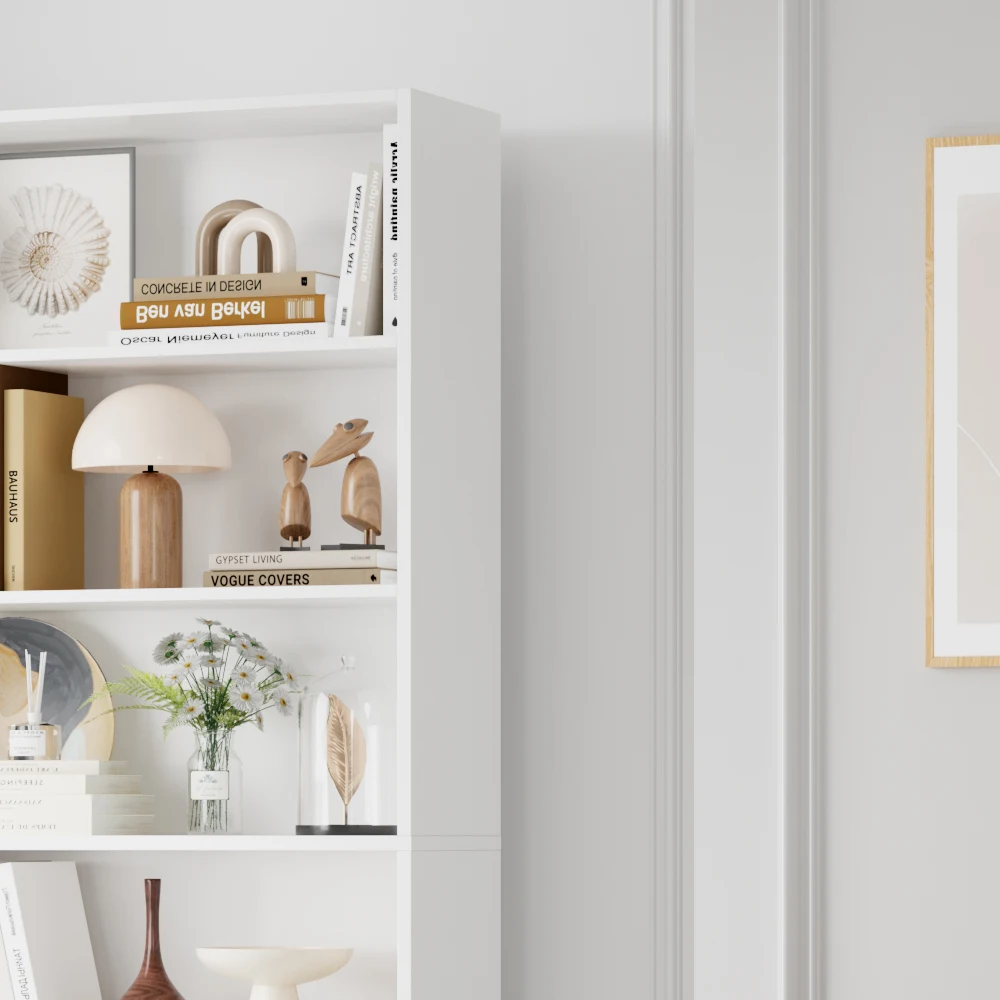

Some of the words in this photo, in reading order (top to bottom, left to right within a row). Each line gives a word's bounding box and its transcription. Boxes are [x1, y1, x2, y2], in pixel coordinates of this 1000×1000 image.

[8, 470, 18, 523] BAUHAUS
[216, 556, 249, 565] GYPSET
[253, 555, 283, 563] LIVING
[211, 575, 254, 587] VOGUE
[258, 574, 310, 586] COVERS
